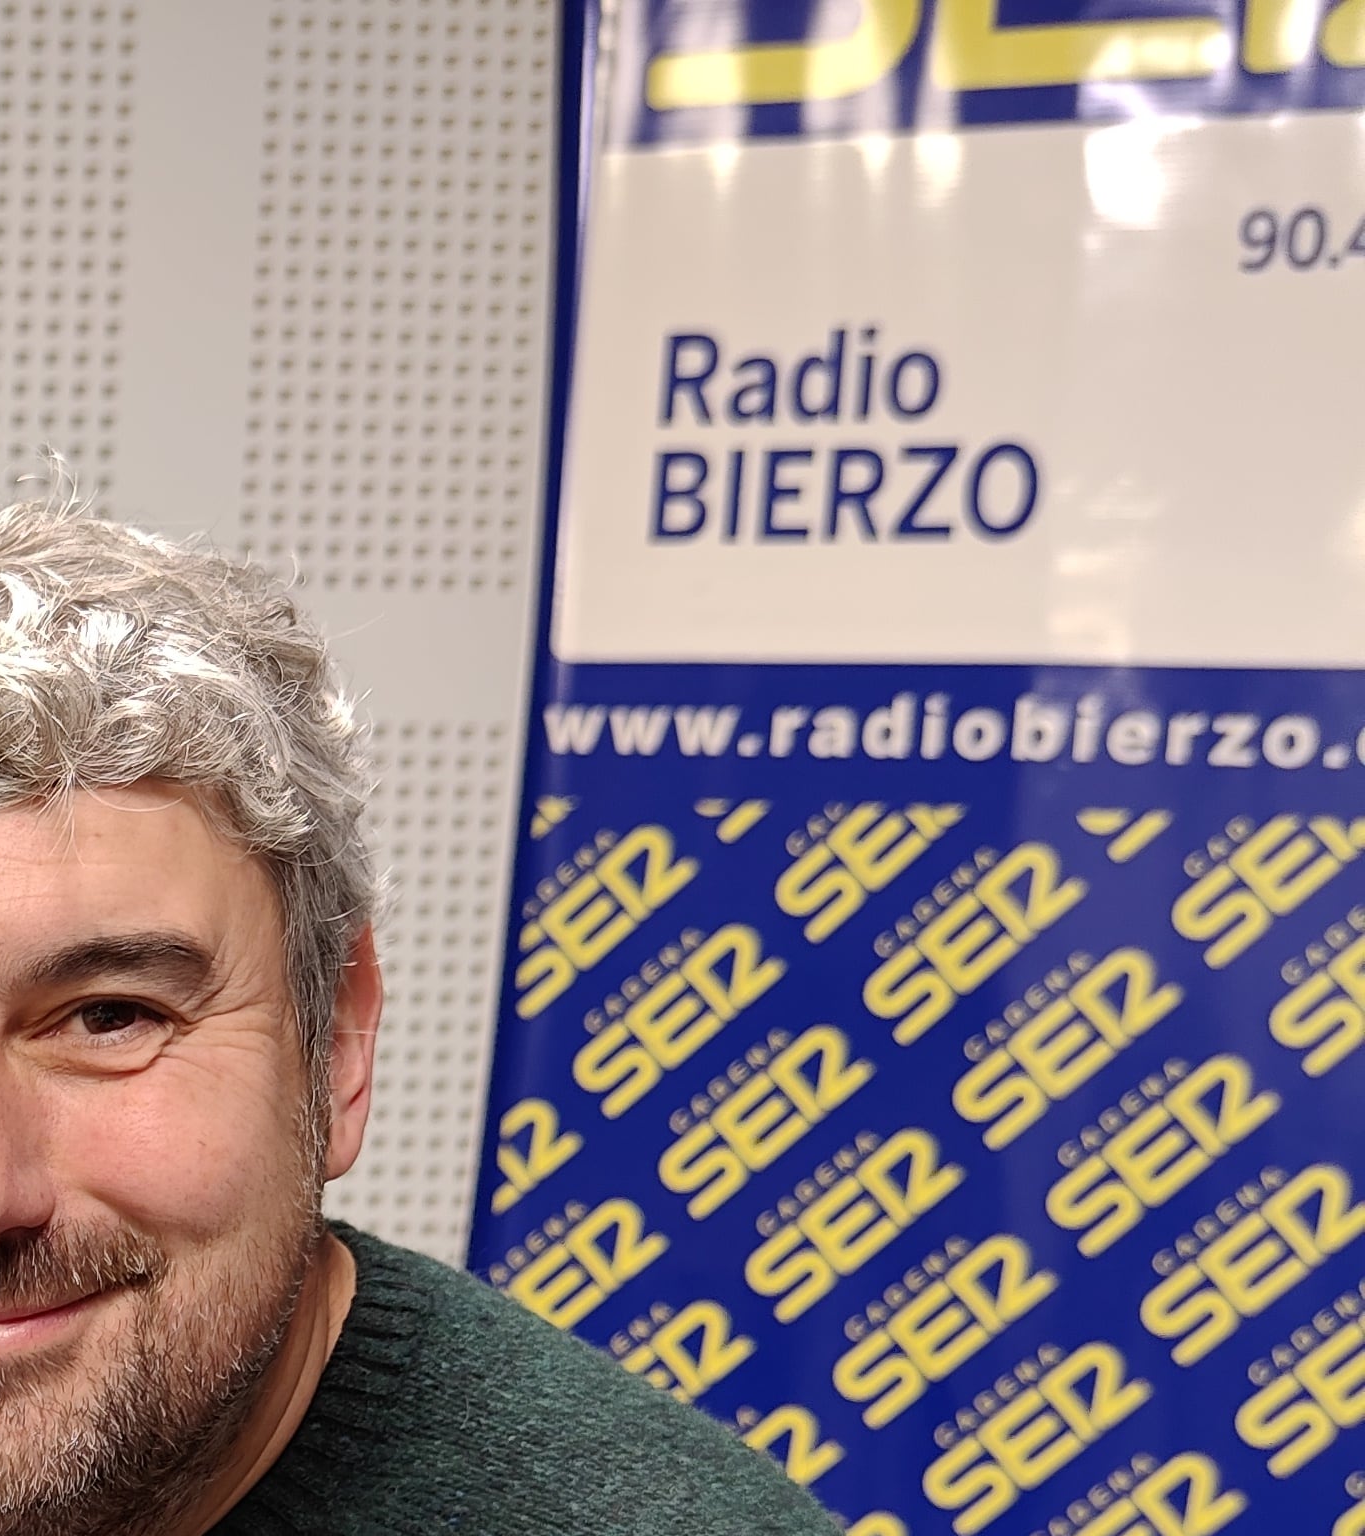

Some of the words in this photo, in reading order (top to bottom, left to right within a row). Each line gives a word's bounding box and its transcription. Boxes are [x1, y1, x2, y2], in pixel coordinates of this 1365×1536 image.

[659, 327, 941, 426] Radio
[649, 438, 1041, 544] BIERZO
[542, 691, 1365, 770] www.radiobierzo.
[573, 925, 785, 1118] SER
[863, 843, 1089, 1045] SER
[658, 1026, 874, 1220] SER
[952, 948, 1183, 1150] SER
[745, 1129, 963, 1323] SER
[1046, 1055, 1280, 1257] SER
[505, 1199, 669, 1330] ER
[833, 1235, 1057, 1428] SER
[1140, 1164, 1365, 1366] SER
[923, 1342, 1152, 1536] SER
[1235, 1313, 1365, 1478] SE
